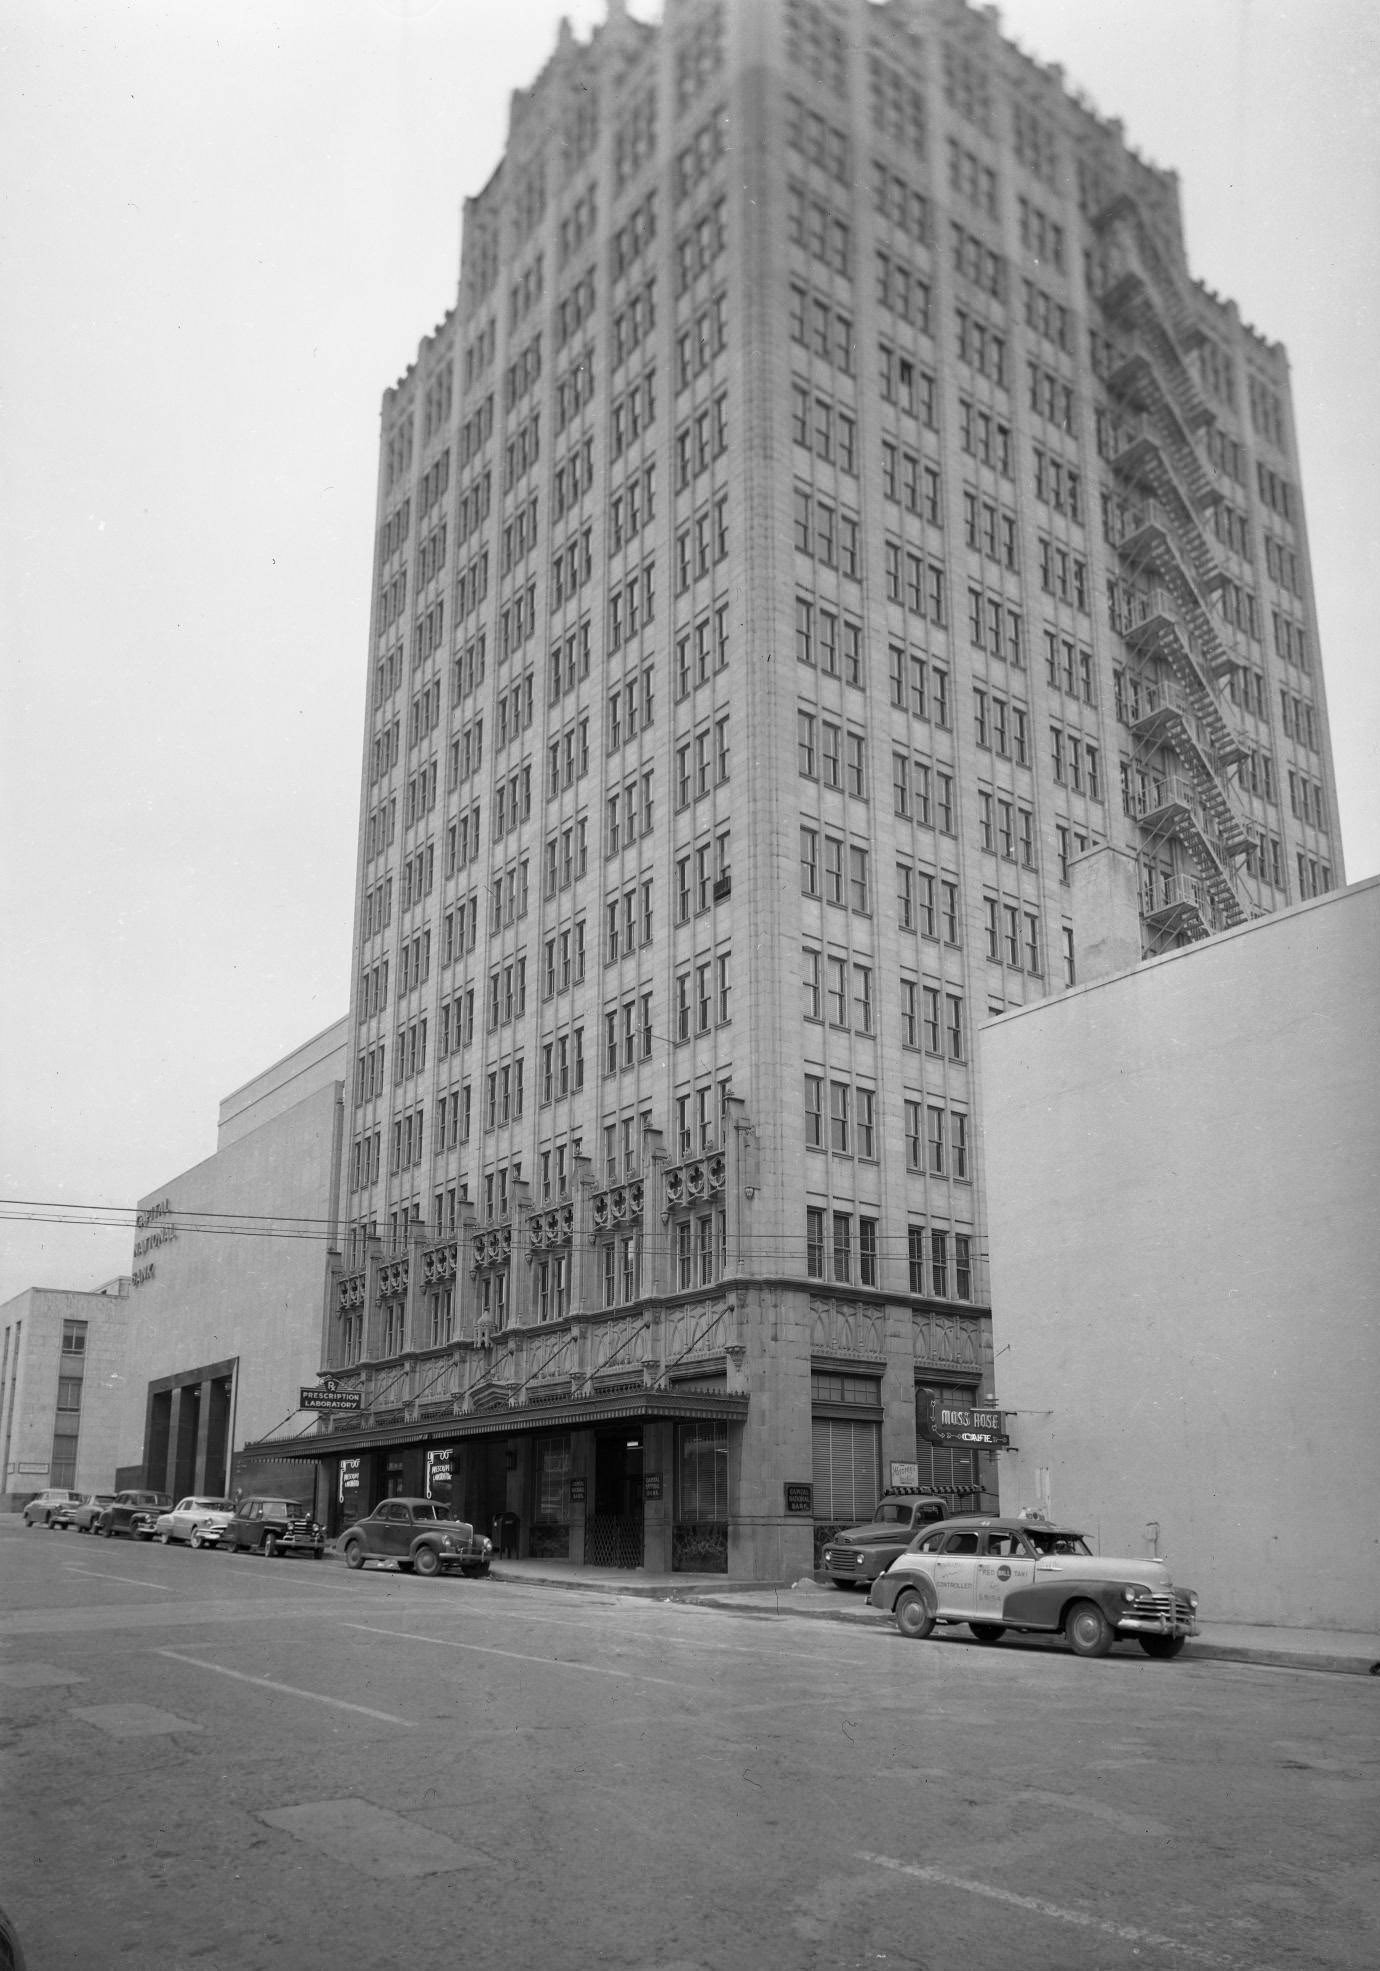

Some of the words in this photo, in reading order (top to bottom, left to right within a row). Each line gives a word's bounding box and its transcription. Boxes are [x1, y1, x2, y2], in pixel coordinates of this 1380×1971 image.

[302, 1391, 360, 1401] PRESCRIPTION
[304, 1400, 357, 1408] LABORATORY
[941, 1409, 971, 1426] MOSS
[973, 1412, 999, 1429] ROSE
[962, 1432, 993, 1443] CAFE
[982, 1568, 995, 1576] RED
